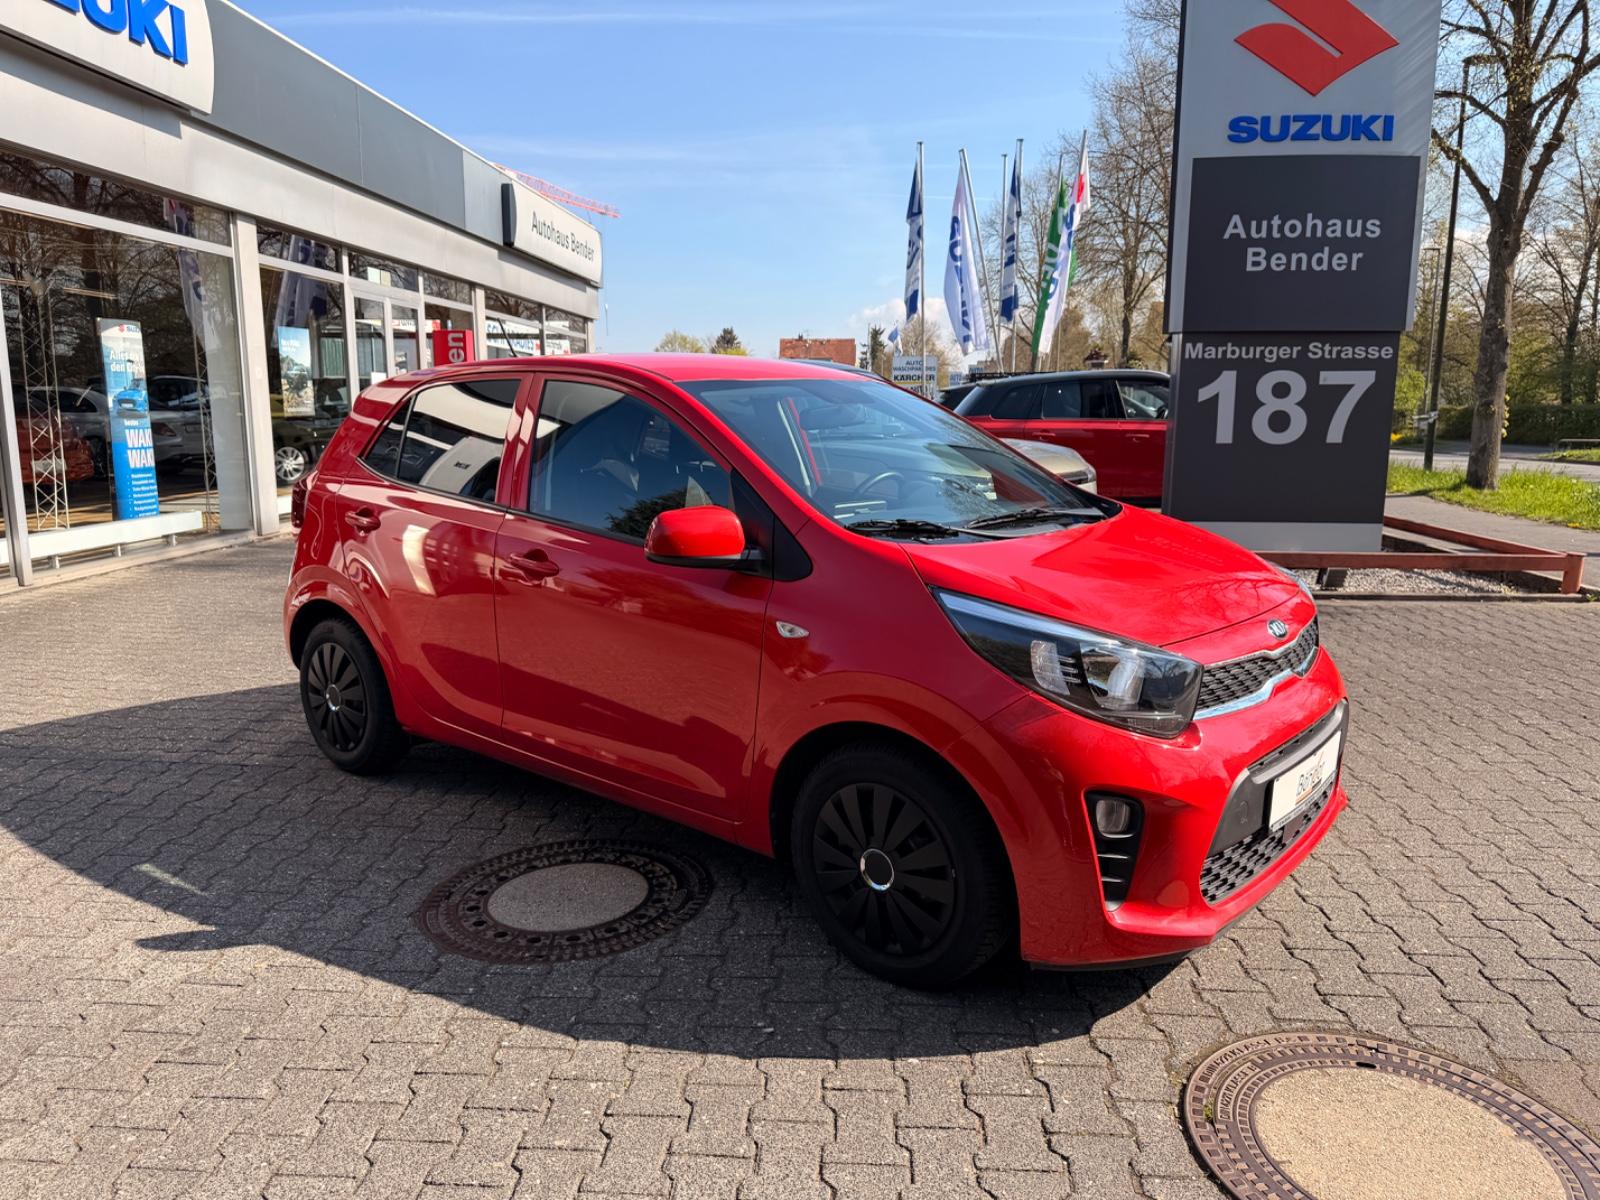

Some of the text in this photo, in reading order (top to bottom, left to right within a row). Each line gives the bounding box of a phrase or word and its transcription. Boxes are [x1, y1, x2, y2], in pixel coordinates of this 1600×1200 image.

[42, 0, 188, 67] UKI
[1227, 114, 1394, 143] SUZUKI
[531, 210, 595, 262] Autohaus Bender
[1223, 213, 1382, 239] Autohaus
[1246, 247, 1363, 272] Bender
[1184, 342, 1393, 362] Marburger Strasse
[1198, 370, 1376, 445] 187
